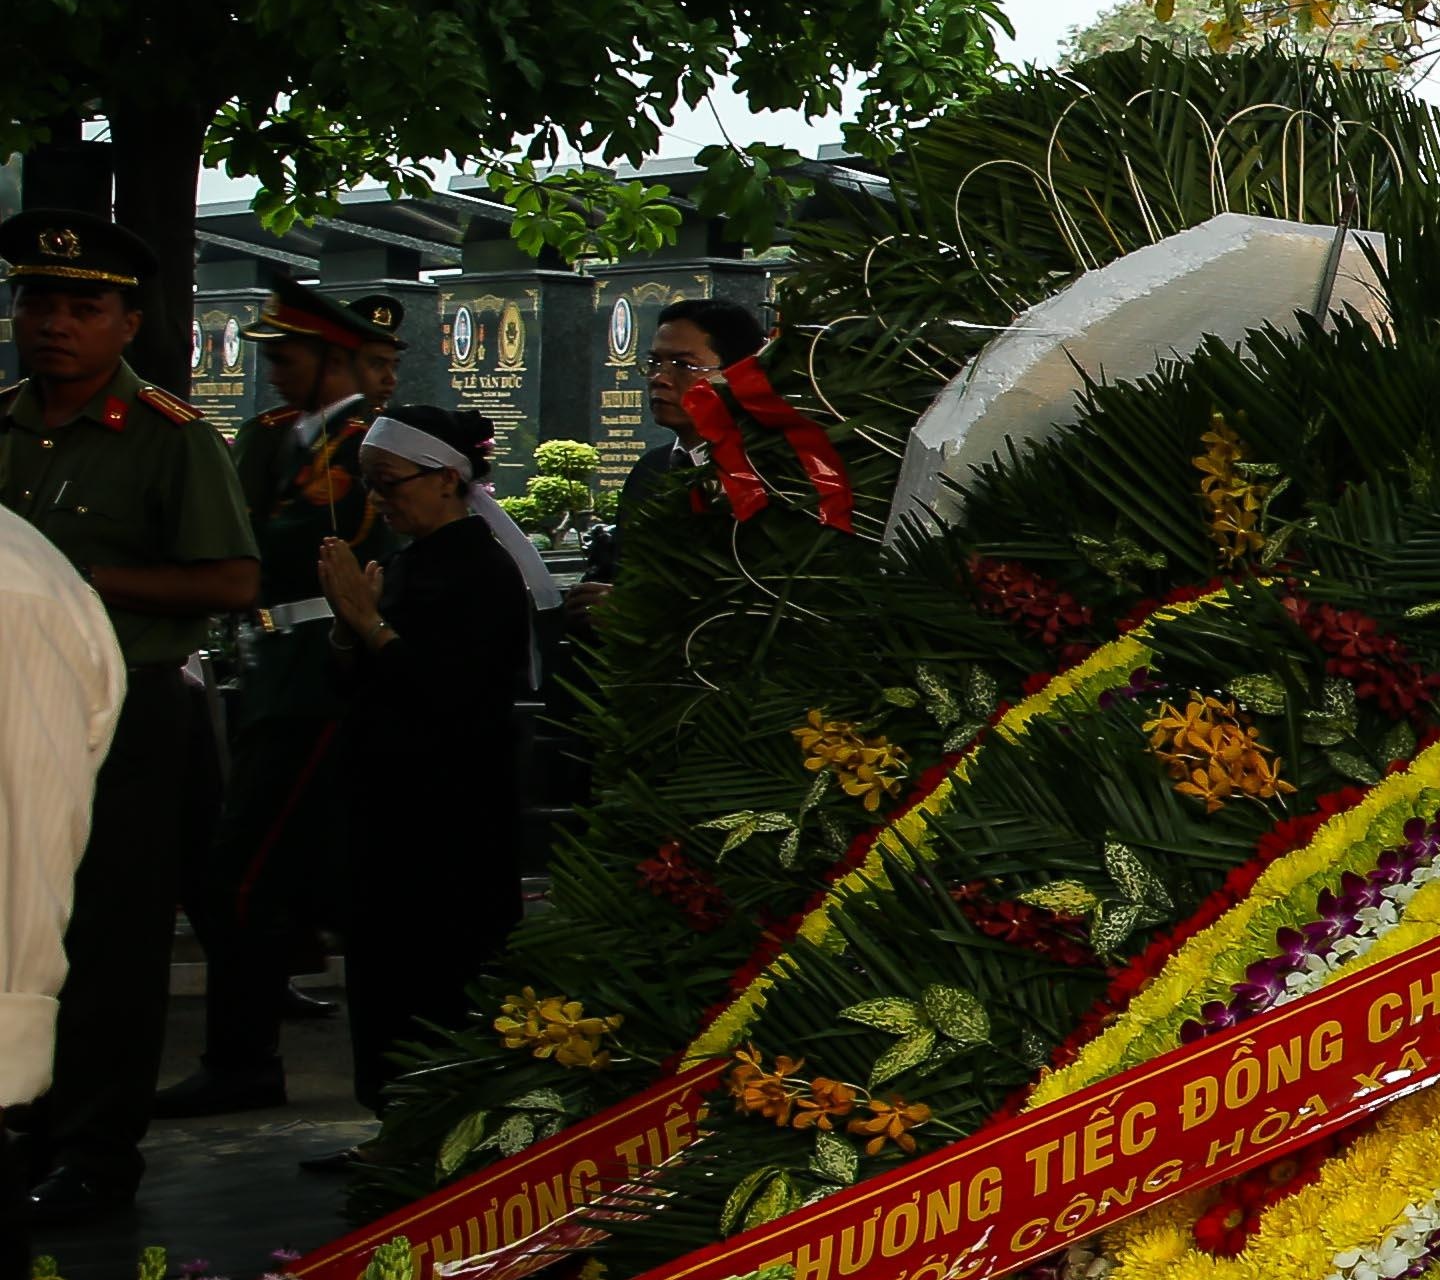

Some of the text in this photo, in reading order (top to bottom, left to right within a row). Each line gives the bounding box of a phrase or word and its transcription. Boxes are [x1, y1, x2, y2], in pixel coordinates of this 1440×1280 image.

[1010, 1158, 1184, 1253] CỘNG
[1205, 1093, 1331, 1168] HÒA
[1351, 1035, 1429, 1099] XÃ
[1025, 1091, 1157, 1197] TIẾC
[1178, 1021, 1344, 1132] ĐỒNG
